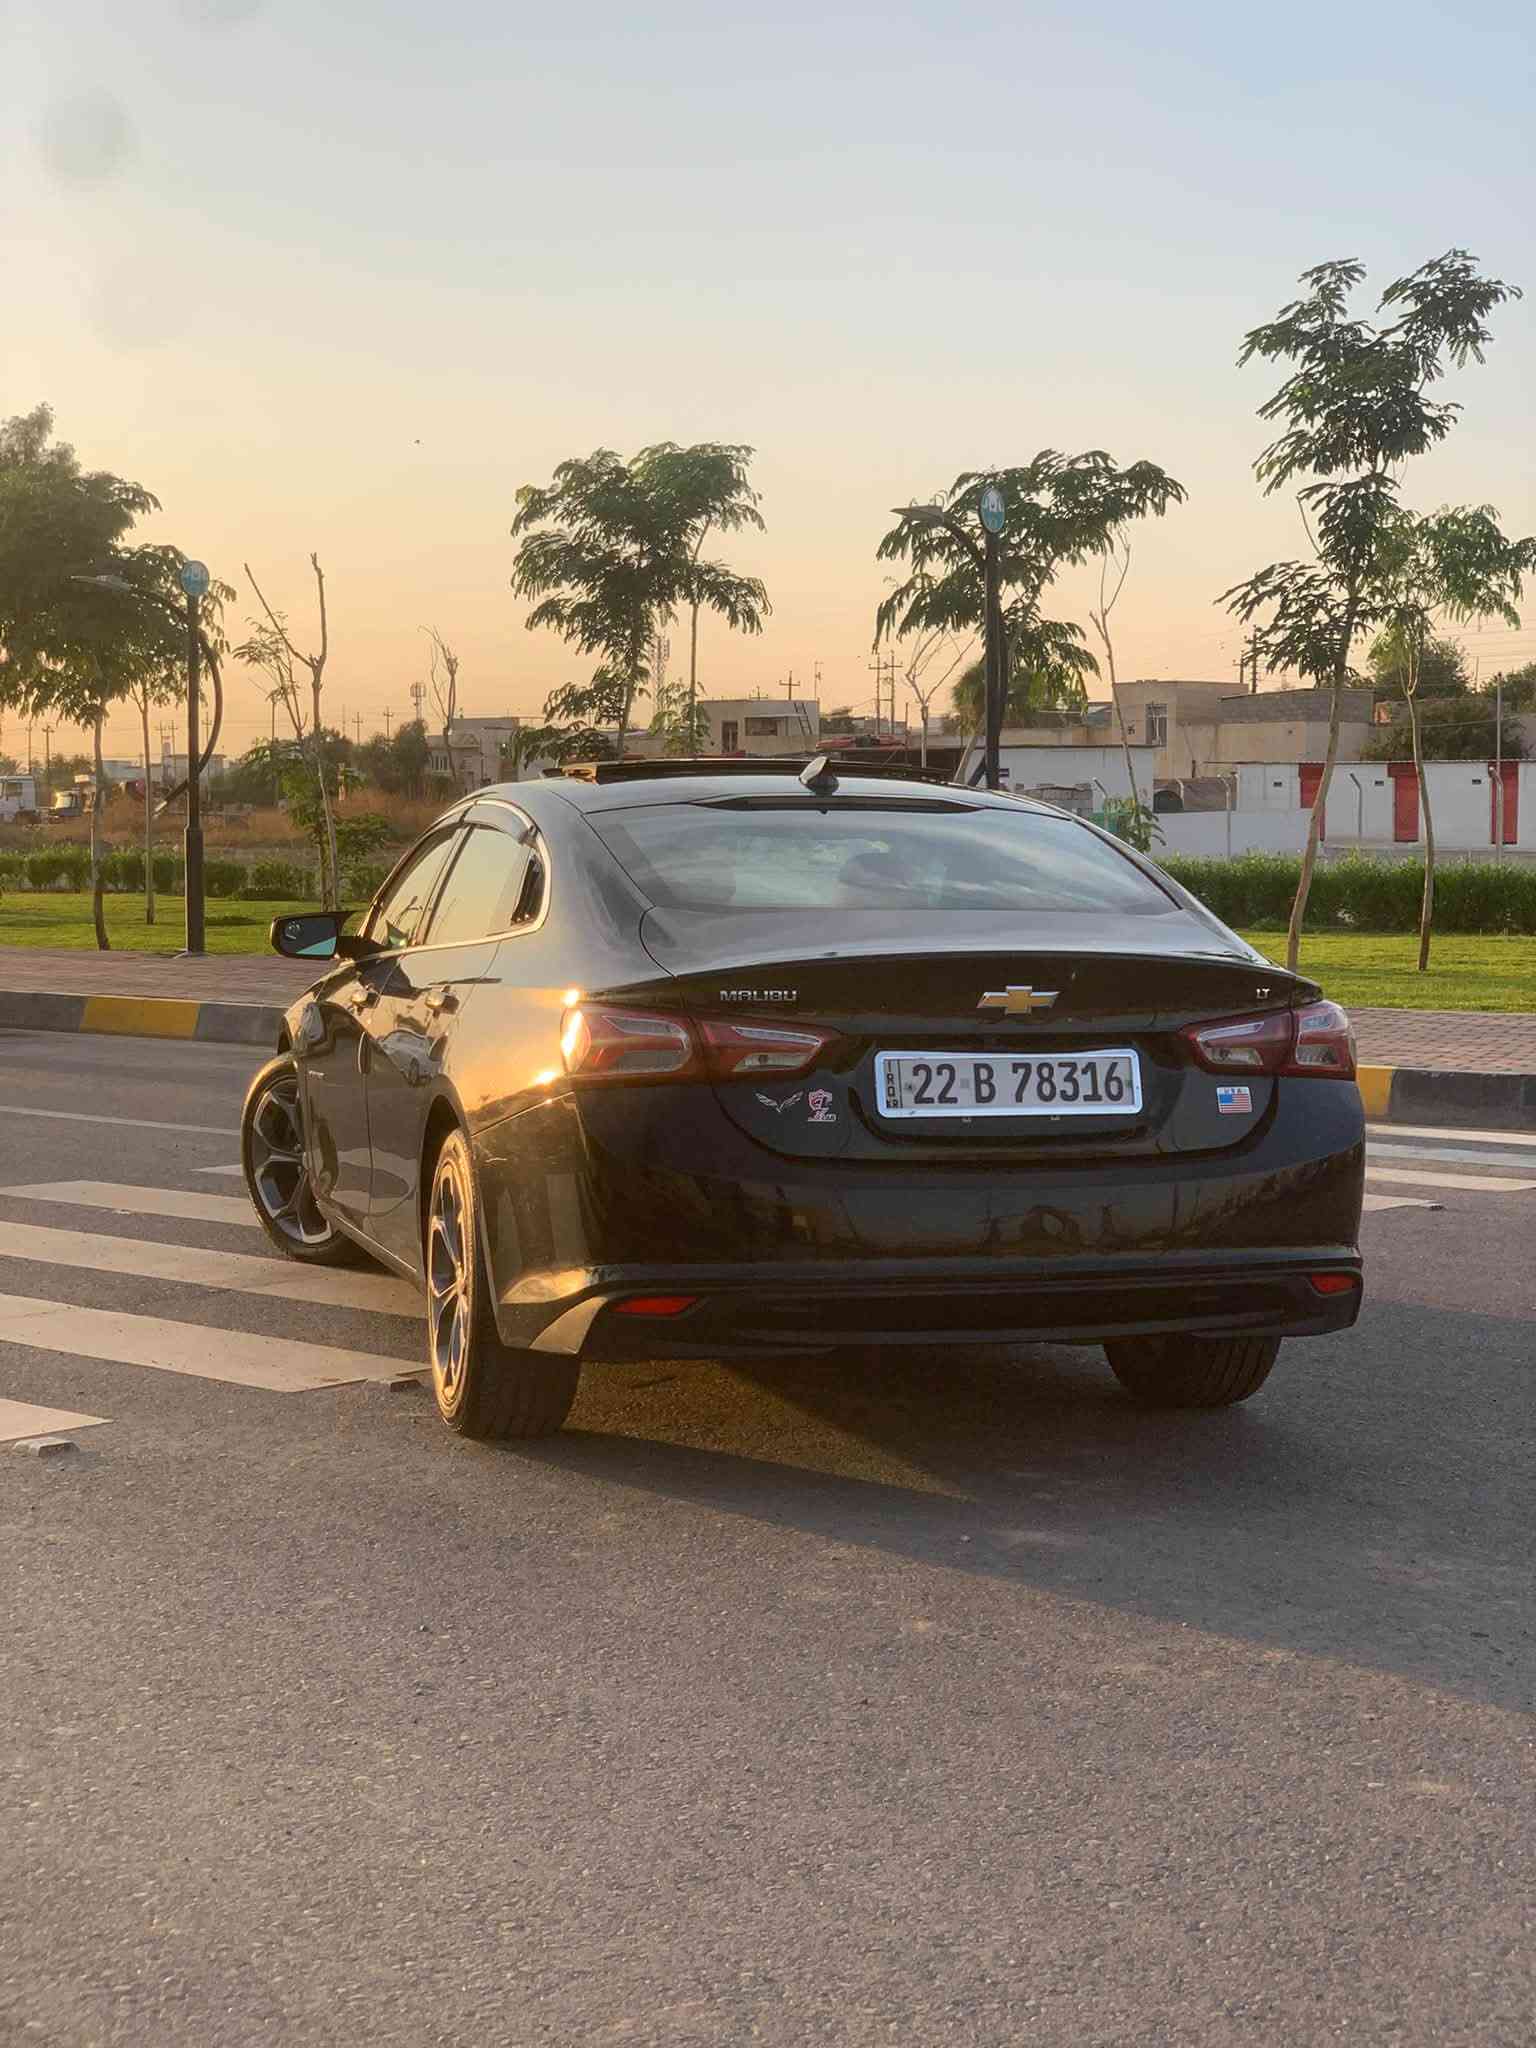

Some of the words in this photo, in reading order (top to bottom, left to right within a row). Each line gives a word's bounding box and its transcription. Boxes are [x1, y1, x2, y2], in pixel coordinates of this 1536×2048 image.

[720, 990, 797, 1001] MALIBU
[1256, 988, 1270, 999] LT
[912, 1063, 959, 1105] 22
[973, 1063, 997, 1104] B
[1011, 1061, 1124, 1103] 78316
